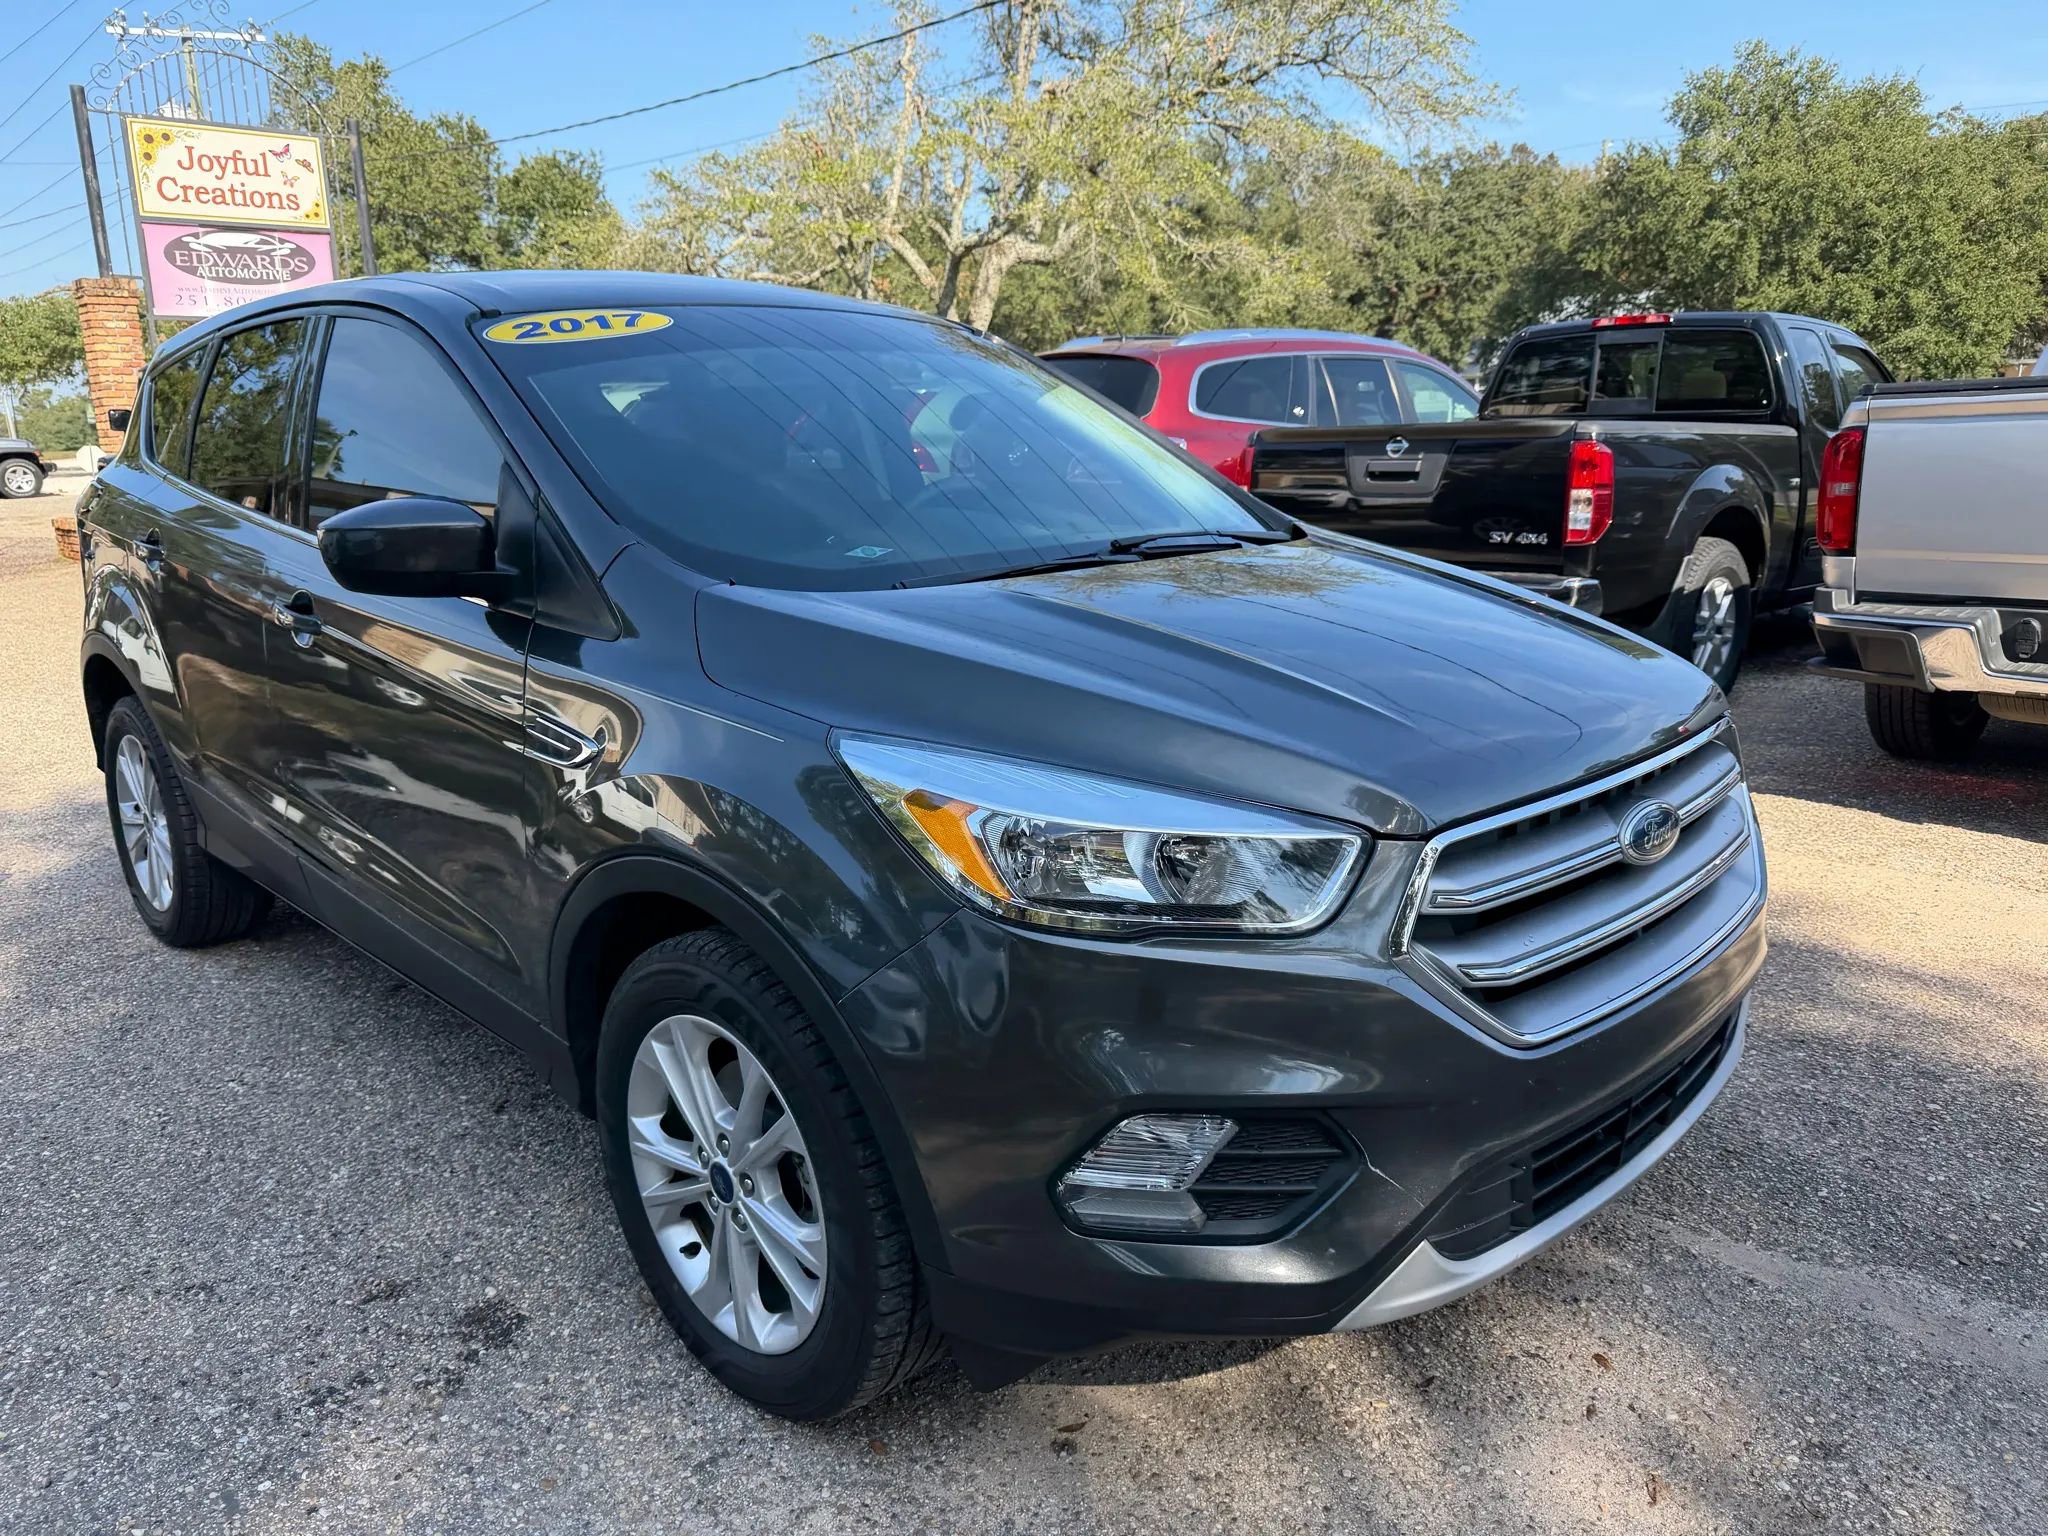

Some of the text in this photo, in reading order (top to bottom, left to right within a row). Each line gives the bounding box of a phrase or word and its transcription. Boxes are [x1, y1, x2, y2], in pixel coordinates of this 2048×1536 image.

[177, 145, 271, 181] Joyful
[156, 176, 301, 211] Creations
[173, 250, 309, 273] EDWARDS
[197, 265, 292, 281] AUTOMOTIVE
[512, 313, 645, 340] 2017
[1488, 531, 1514, 544] SV
[1643, 814, 1676, 850] Ford
